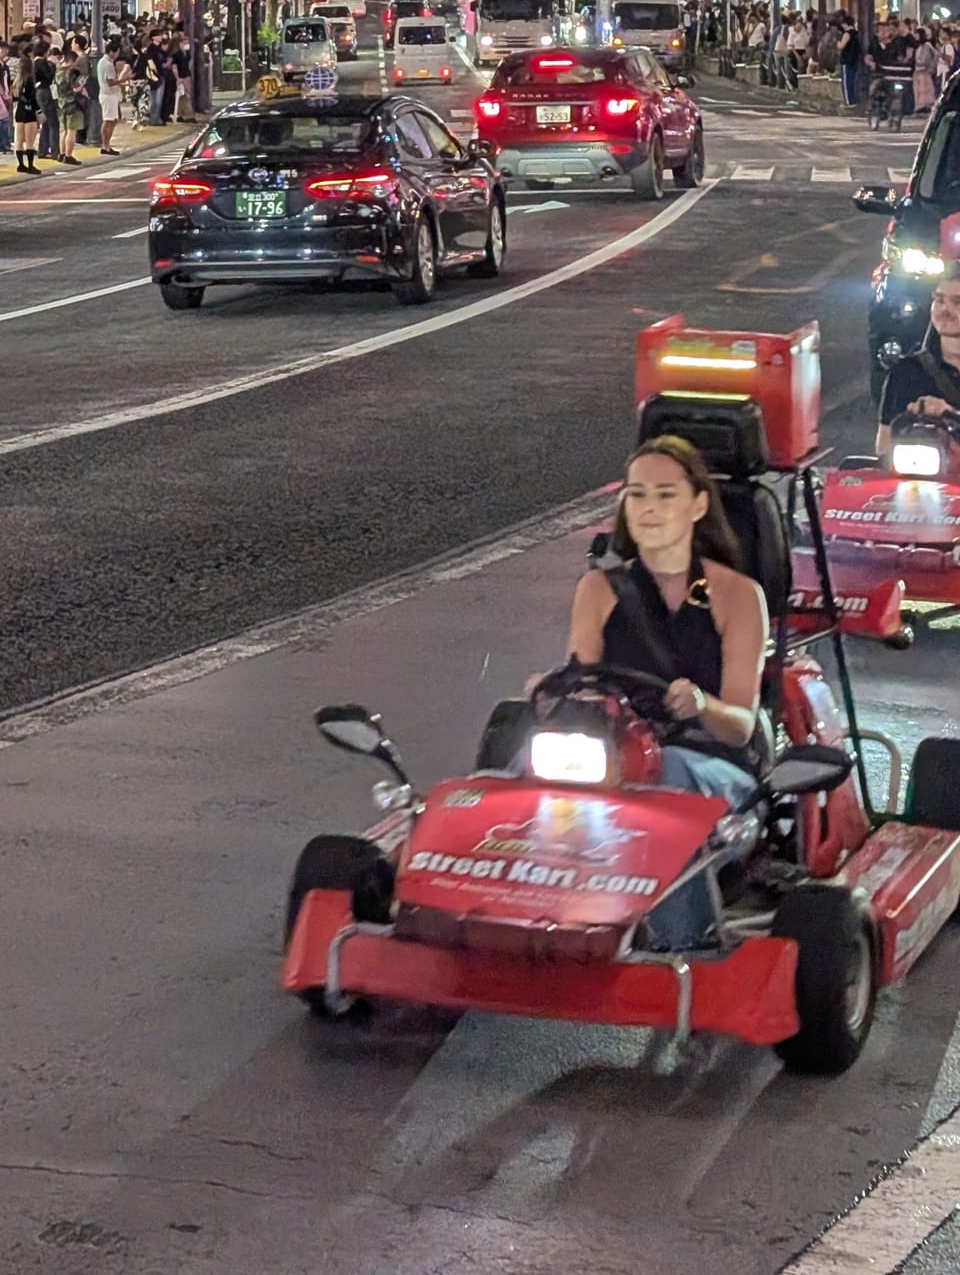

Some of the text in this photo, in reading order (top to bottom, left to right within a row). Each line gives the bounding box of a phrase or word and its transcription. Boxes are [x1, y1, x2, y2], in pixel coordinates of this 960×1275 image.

[247, 202, 284, 215] 17-96
[824, 508, 883, 521] Street
[408, 851, 507, 876] Street
